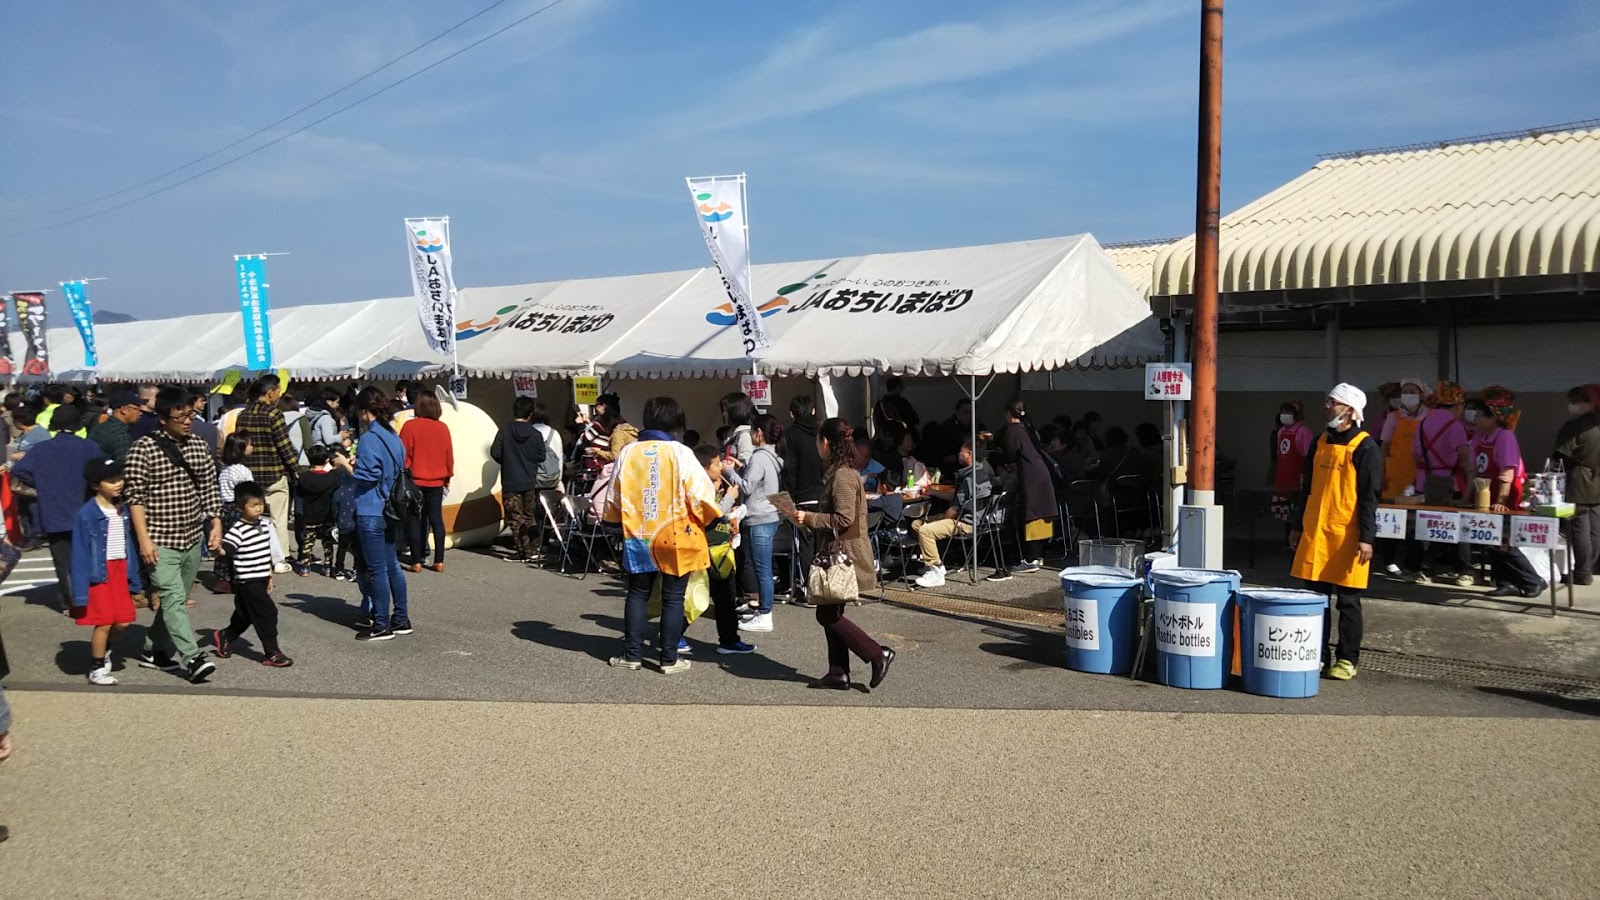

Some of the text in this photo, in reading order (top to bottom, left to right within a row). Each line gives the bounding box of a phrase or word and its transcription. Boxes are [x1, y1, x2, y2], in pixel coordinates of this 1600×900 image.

[787, 288, 973, 315] JAおちいまばり
[492, 311, 615, 334] JAおちいまばり
[450, 378, 465, 394] 本部
[743, 379, 768, 390] 女性部
[1164, 383, 1181, 395] 女性部
[649, 457, 658, 520] JAおちいまばり
[1469, 519, 1497, 529] うどん
[1429, 529, 1454, 541] 350円
[1470, 529, 1499, 542] 300円
[1160, 612, 1204, 631] ペットボトル
[1179, 631, 1211, 648] bottles
[1268, 626, 1311, 643] ビン・カン
